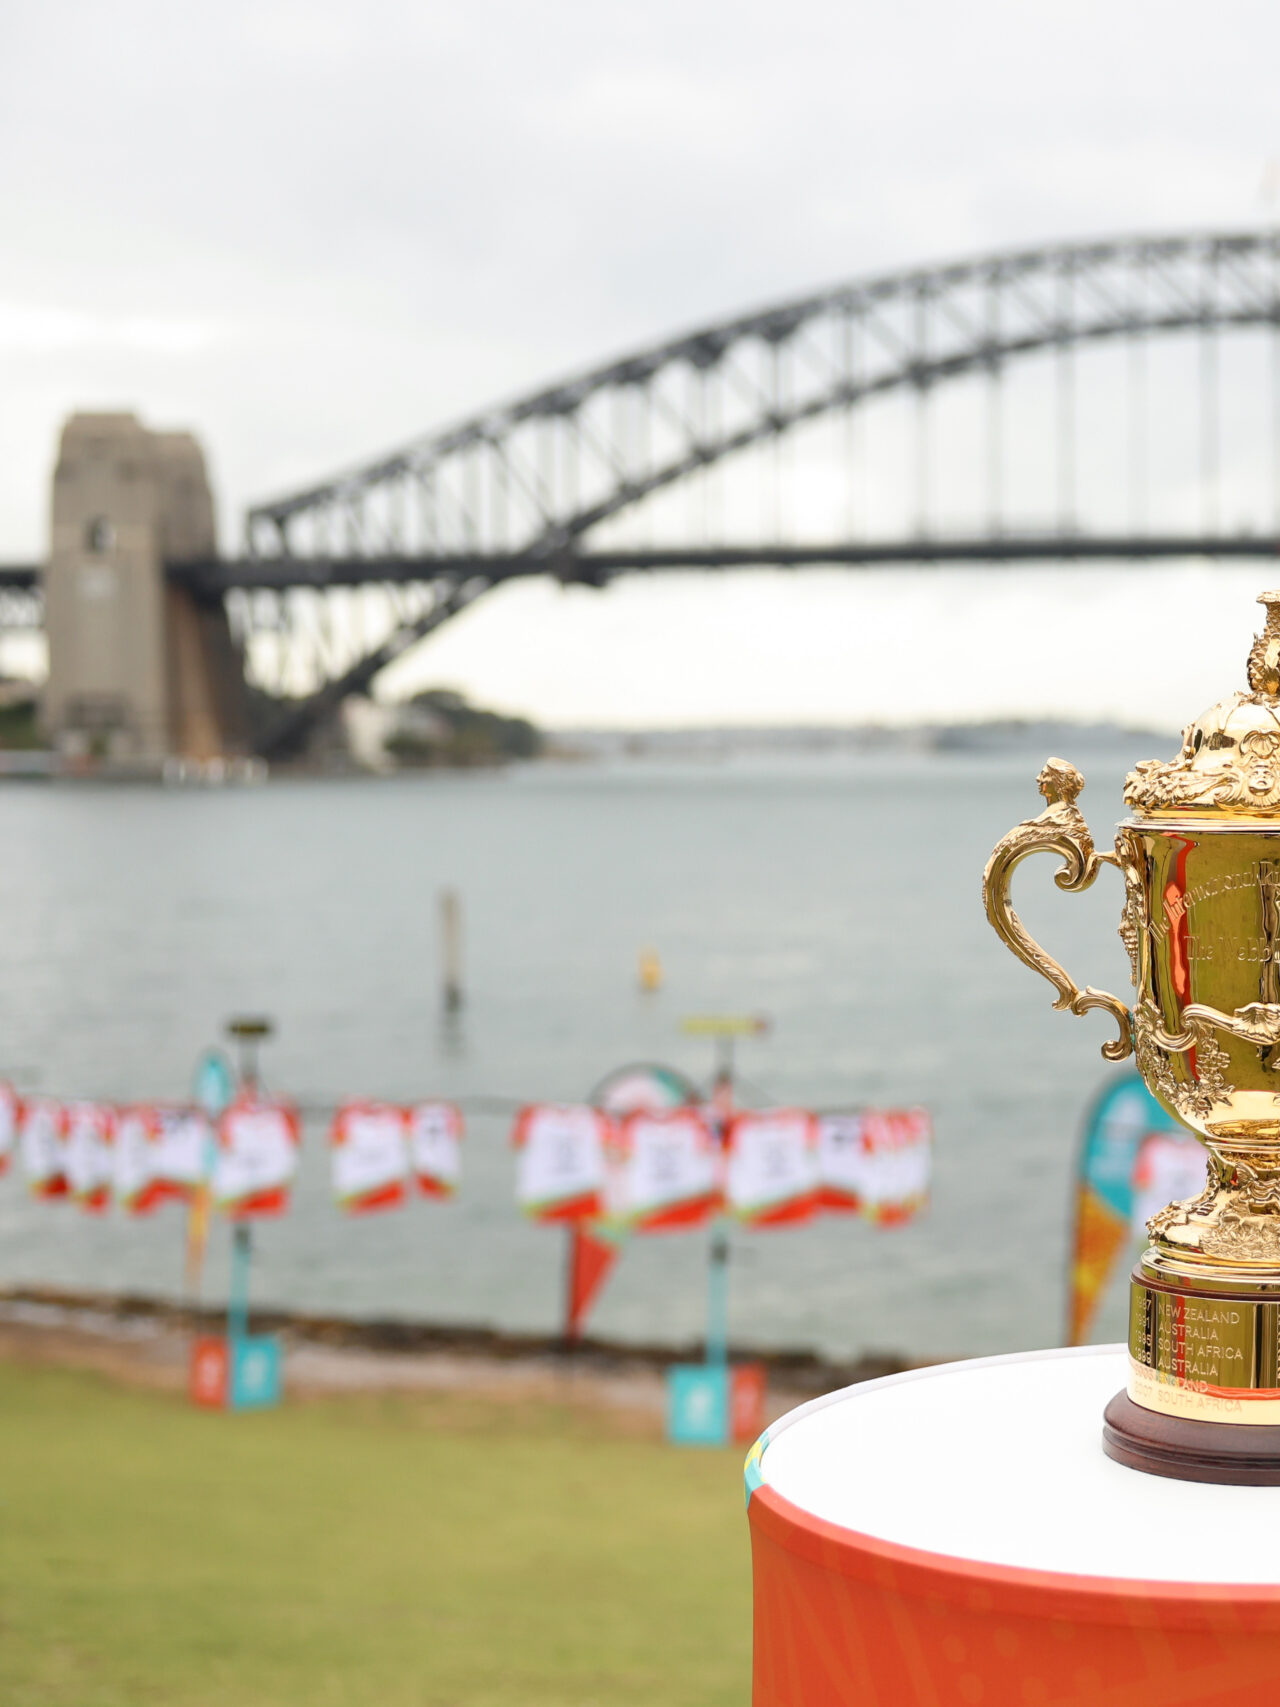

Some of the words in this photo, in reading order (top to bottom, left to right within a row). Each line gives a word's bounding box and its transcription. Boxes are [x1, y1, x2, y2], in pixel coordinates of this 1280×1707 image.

[1183, 935, 1214, 961] The
[1158, 1303, 1181, 1318] NEW
[1183, 1306, 1241, 1325] ZEALAND
[1157, 1321, 1219, 1341] AUSTRALIA
[1157, 1337, 1195, 1357] SOUTH
[1196, 1345, 1244, 1361] AFRICA
[1157, 1356, 1219, 1377] AUSTRALIA
[1158, 1389, 1193, 1407] SOUTH
[1196, 1397, 1244, 1413] AFRICA
